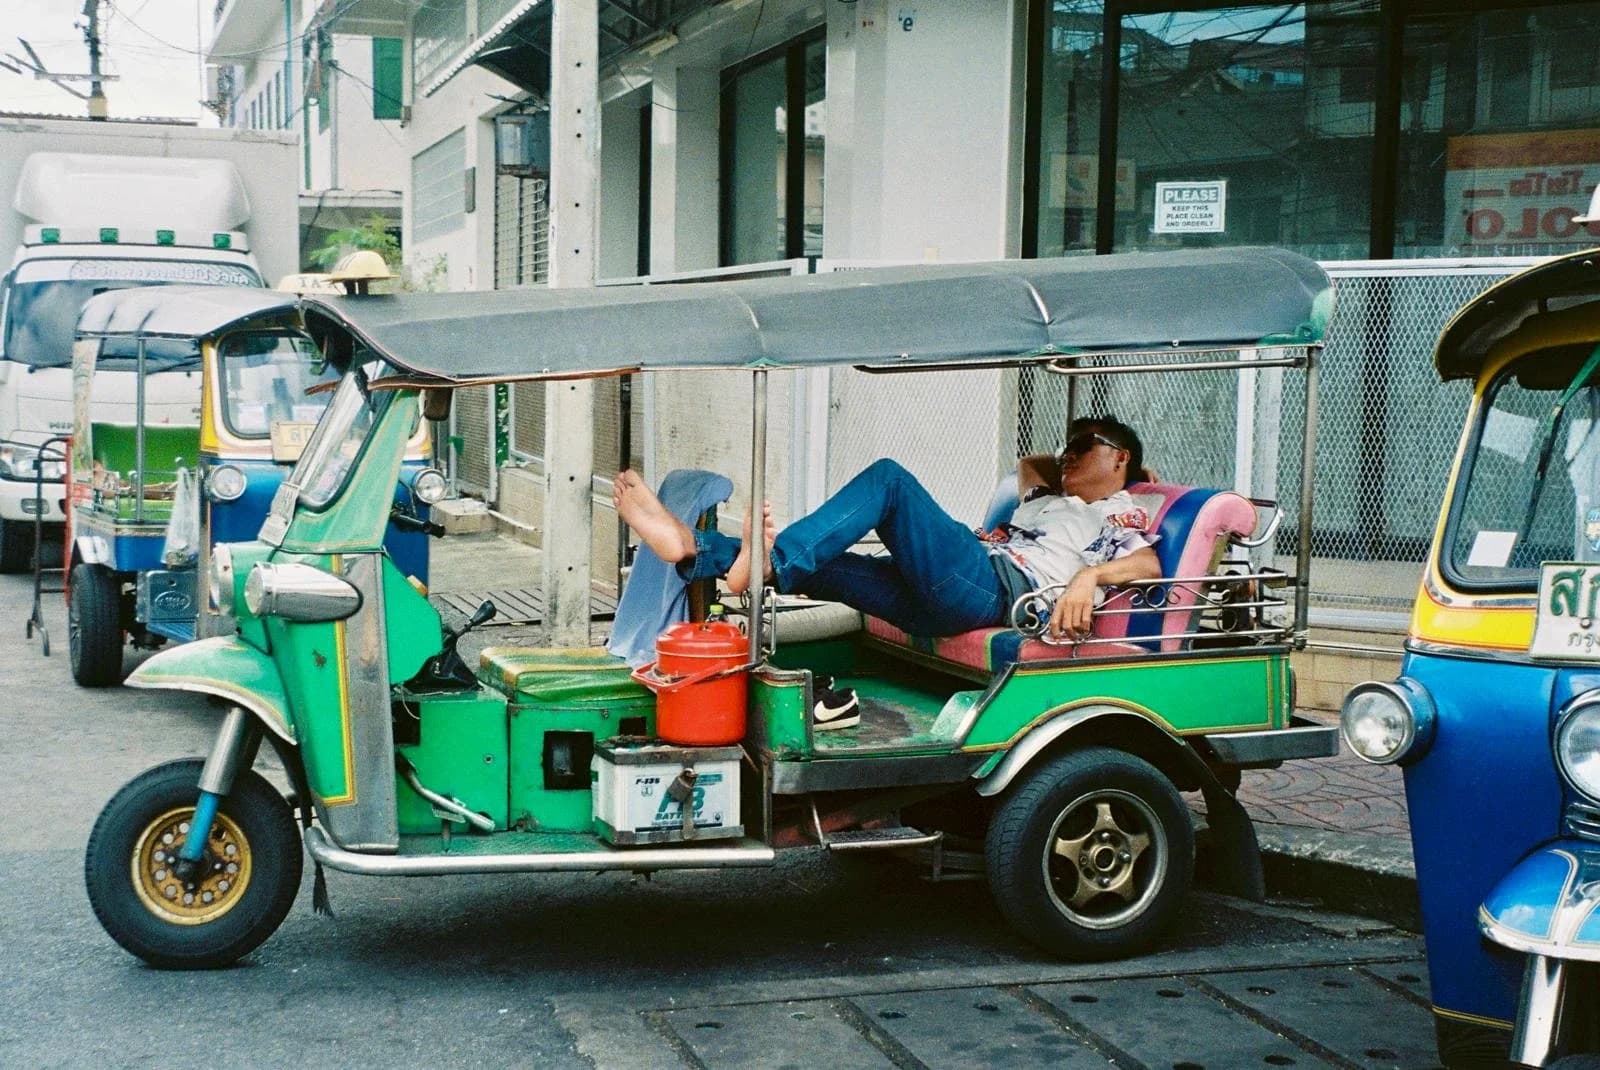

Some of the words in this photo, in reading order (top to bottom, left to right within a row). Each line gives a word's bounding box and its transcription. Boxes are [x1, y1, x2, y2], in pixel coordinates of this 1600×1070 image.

[1165, 189, 1217, 202] PLEASE
[1172, 204, 1190, 212] KEEP
[655, 811, 703, 821] BATTY
